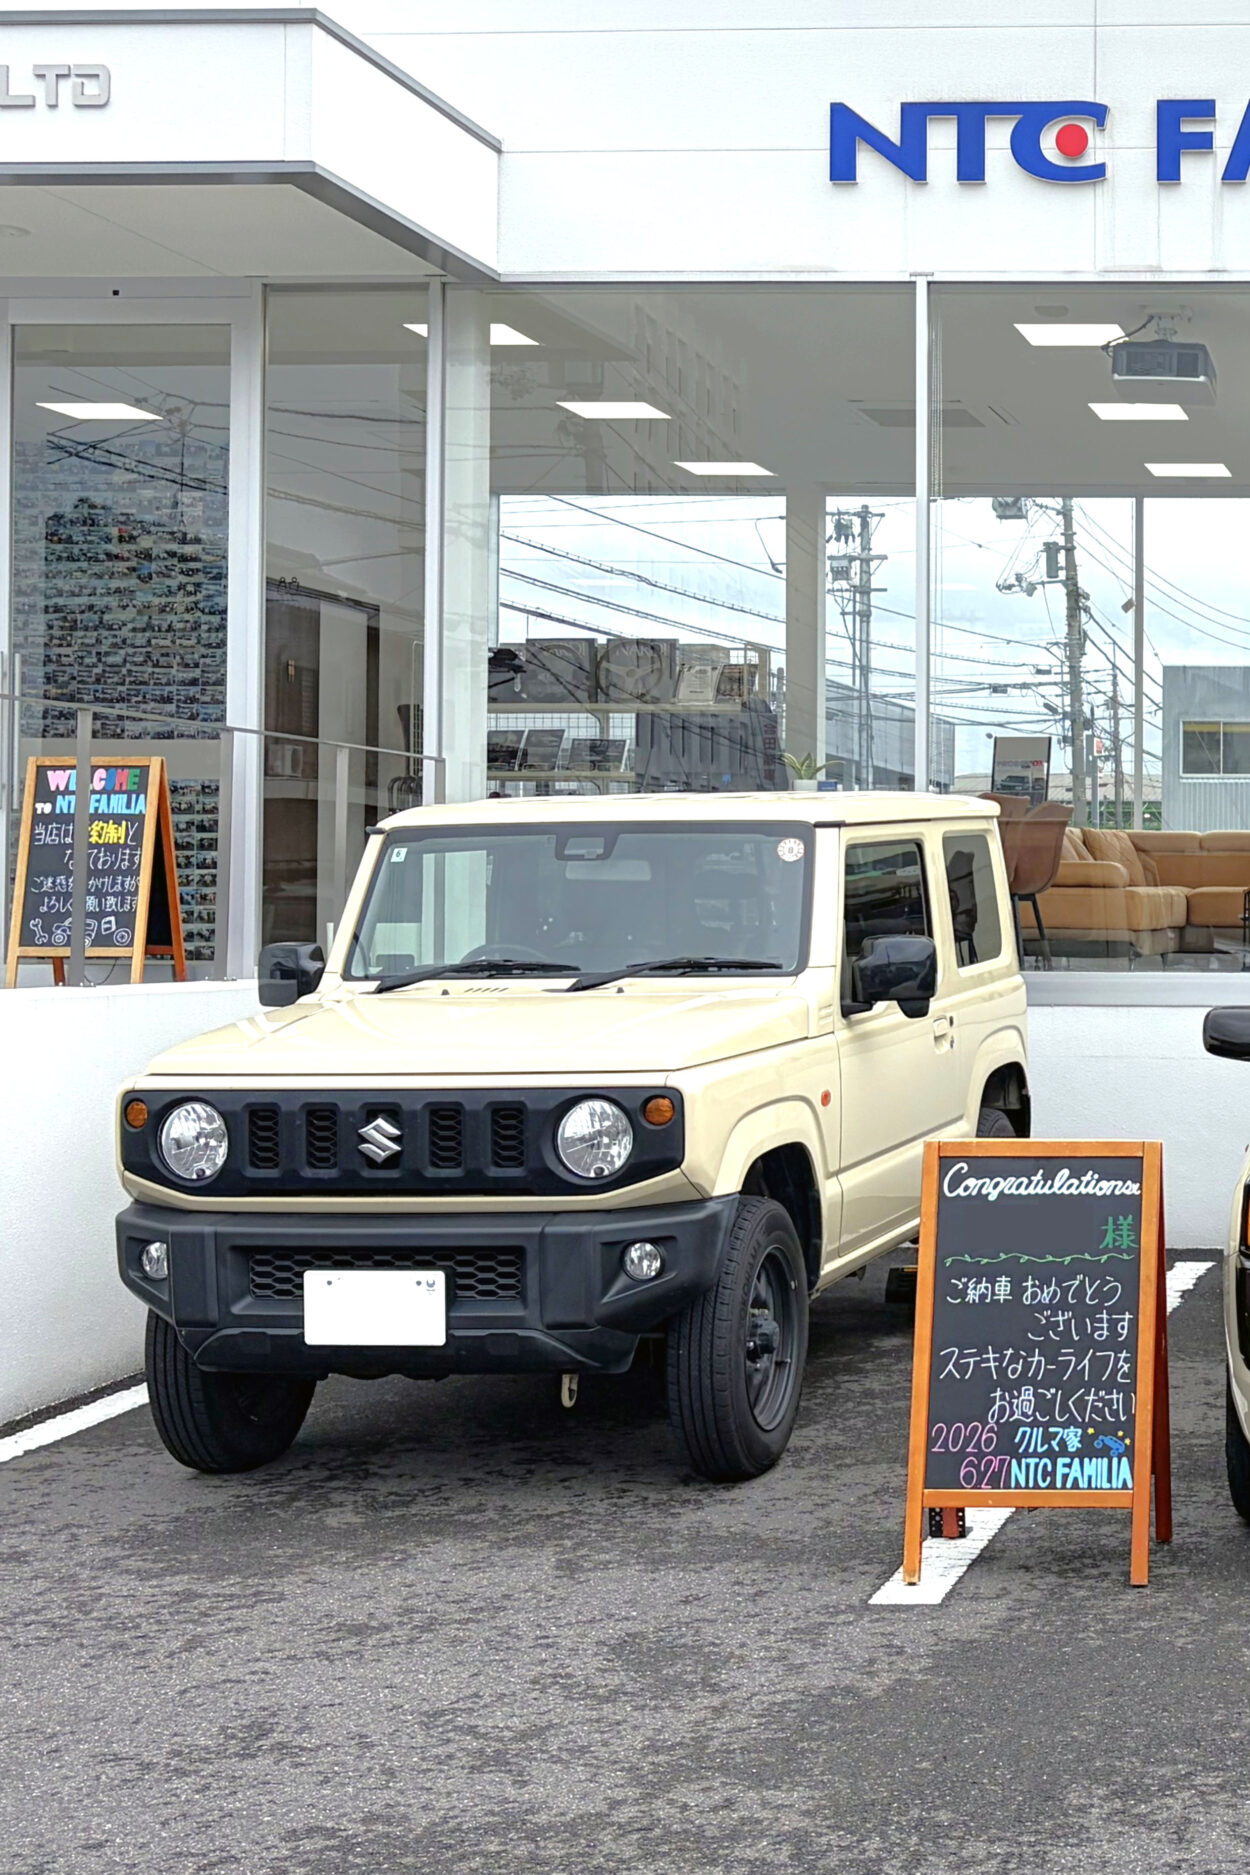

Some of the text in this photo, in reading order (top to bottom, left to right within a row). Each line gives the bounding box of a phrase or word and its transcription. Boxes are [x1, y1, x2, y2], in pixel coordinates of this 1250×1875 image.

[829, 100, 1110, 183] NTC
[89, 794, 146, 814] FAMILIA
[943, 1162, 1141, 1201] Congratulations
[1099, 1214, 1139, 1249] 様
[946, 1273, 1122, 1306] ご納車 おめでとう
[1027, 1309, 1134, 1341] ございます
[938, 1345, 1132, 1383] ステキなカーライフを
[987, 1386, 1136, 1423] お過ごしください
[931, 1421, 998, 1452] 2026
[1013, 1426, 1083, 1453] クルマ家
[1010, 1457, 1134, 1489] NTC FAMILIA
